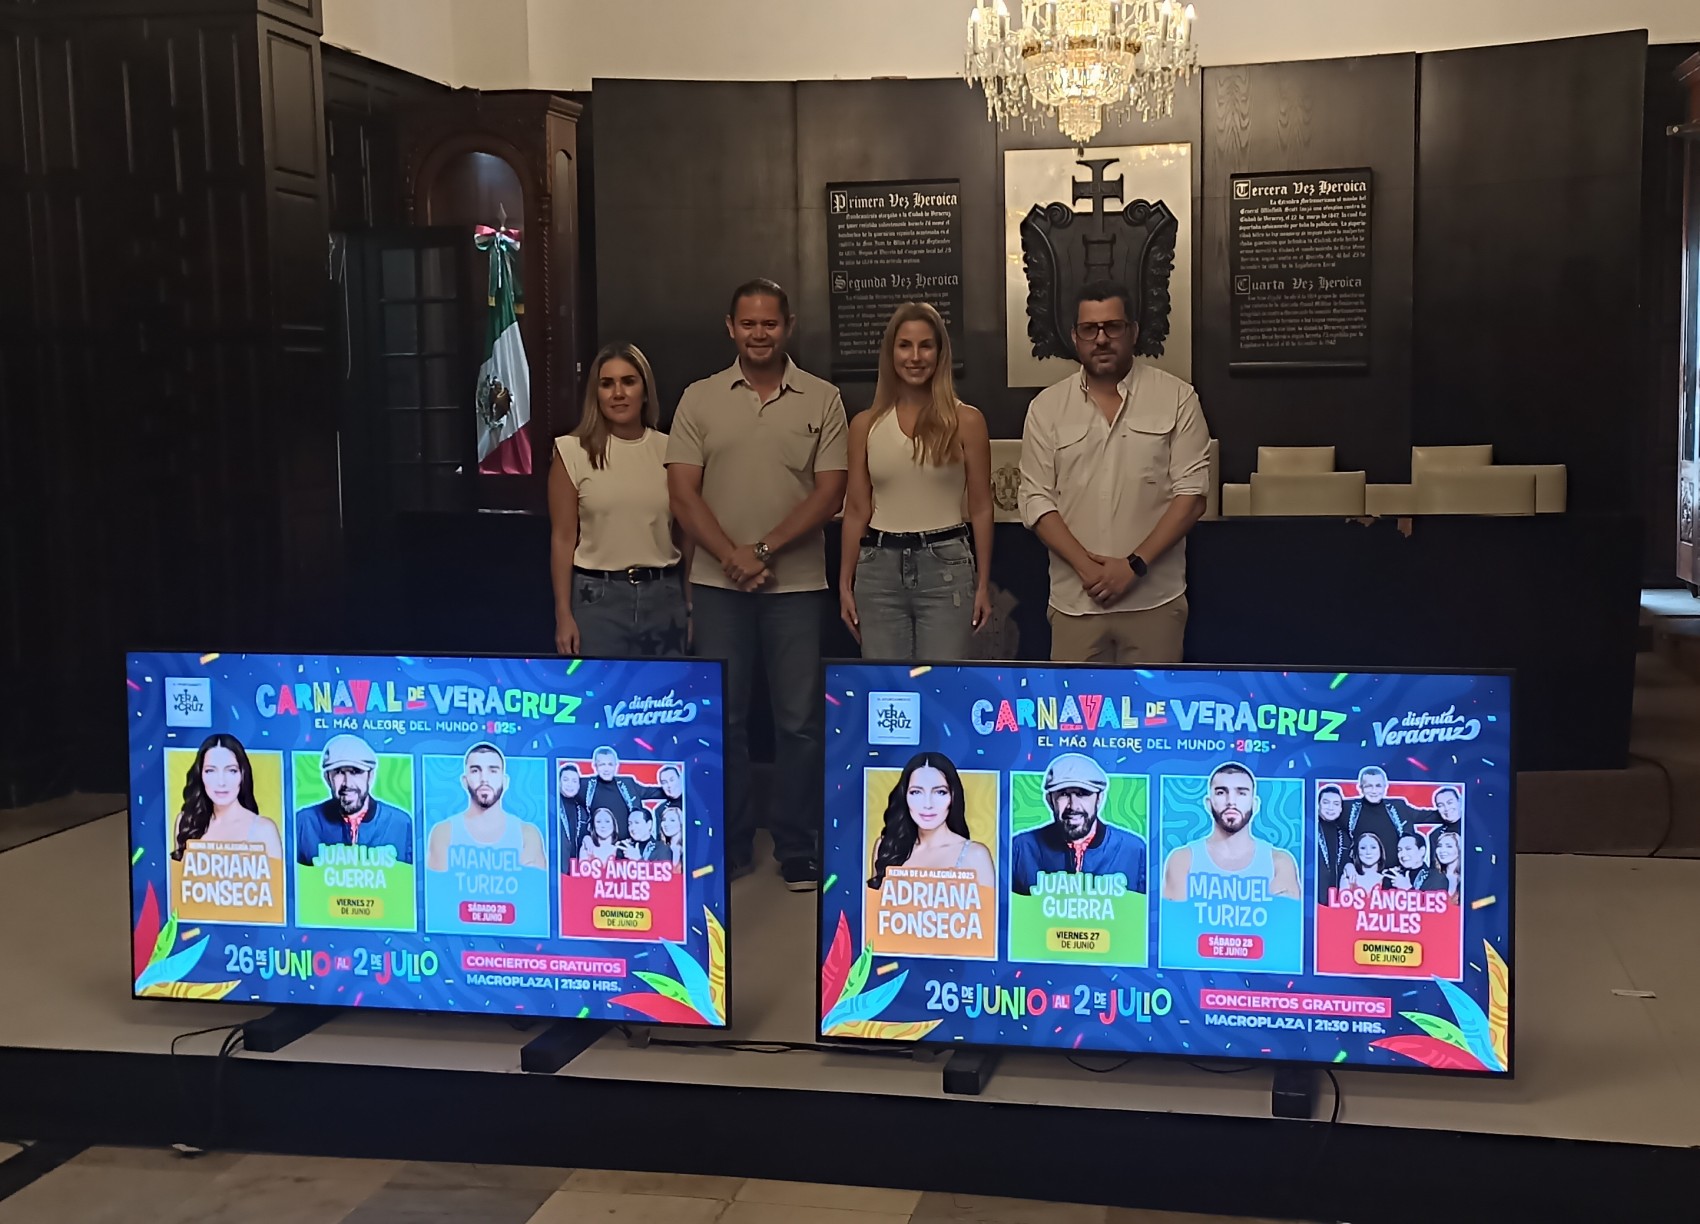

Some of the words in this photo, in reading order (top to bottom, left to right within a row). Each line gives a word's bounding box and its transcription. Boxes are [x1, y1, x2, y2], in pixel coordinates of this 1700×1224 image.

[1235, 181, 1288, 198] Tercera
[1293, 182, 1315, 196] Vez
[1319, 180, 1366, 195] Heroica
[832, 193, 885, 212] Primera
[889, 193, 909, 209] Vez
[913, 192, 957, 208] Heroica
[834, 274, 887, 291] Segunda
[891, 273, 911, 289] Vez
[915, 273, 959, 288] Heroica
[1236, 278, 1285, 292] Cuarta
[1293, 277, 1314, 290] Vez
[1318, 276, 1362, 291] Heroica
[173, 693, 199, 702] VERA
[178, 702, 204, 712] CRUZ
[256, 679, 402, 718] CARNAVAL
[407, 686, 426, 701] DE
[428, 684, 582, 723] VERACRUZ
[604, 701, 697, 728] Veracruz
[877, 709, 907, 719] VERA
[882, 718, 912, 729] CRUZ
[971, 694, 1139, 735] CARNAVAL
[1146, 700, 1167, 716] DE
[1170, 699, 1347, 742] VERACRUZ
[315, 718, 329, 729] EL
[362, 719, 407, 735] ALEGRE
[410, 720, 431, 732] DEL
[435, 721, 478, 733] MUNDO
[1372, 717, 1481, 747] Veracruz
[1038, 736, 1054, 748] EL
[1059, 734, 1087, 749] MÁS
[1093, 737, 1143, 752] ALEGRE
[1147, 738, 1171, 750] DEL
[1177, 739, 1226, 751] MUNDO
[183, 852, 271, 880] ADRIANA
[314, 844, 358, 867] JUAN
[360, 845, 397, 868] LUIS
[450, 847, 522, 872] MANUEL
[324, 866, 387, 889] GUERRA
[570, 859, 602, 878] LOS
[606, 856, 673, 881] ÁNGELES
[909, 870, 918, 878] DE
[919, 870, 928, 878] LA
[181, 880, 273, 907] FONSECA
[455, 873, 518, 895] TURIZO
[594, 880, 650, 900] AZULES
[1032, 872, 1082, 896] JUAN
[1086, 873, 1127, 897] LUIS
[1190, 875, 1273, 902] MANUEL
[336, 898, 365, 907] VIERNES
[366, 899, 375, 907] 27
[881, 879, 982, 910] ADRIANA
[1328, 888, 1364, 909] LOS
[1369, 886, 1448, 914] ÁNGELES
[341, 907, 349, 915] DE
[351, 907, 371, 915] JUNIO
[472, 912, 482, 921] DE
[482, 912, 503, 922] JUNIO
[600, 909, 634, 919] DOMINGO
[635, 910, 645, 919] 29
[1042, 896, 1115, 921] GUERRA
[1194, 902, 1268, 928] TURIZO
[607, 918, 615, 927] DE
[617, 919, 638, 928] JUNIO
[878, 910, 983, 940] FONSECA
[1355, 911, 1421, 934] AZULES
[1056, 931, 1089, 940] VIERNES
[1090, 932, 1100, 941] 27
[1061, 940, 1071, 949] DE
[1072, 941, 1095, 950] JUNIO
[1208, 936, 1241, 947] SÁBADO
[1242, 938, 1254, 947] 28
[224, 944, 254, 974] 26
[256, 949, 267, 961] DE
[1213, 947, 1223, 956] DE
[1224, 947, 1248, 957] JUNIO
[1362, 944, 1401, 954] DOMINGO
[1403, 945, 1414, 954] 29
[1370, 953, 1380, 962] DE
[1382, 954, 1406, 963] JUNIO
[259, 947, 331, 981] JUNIO
[335, 957, 349, 970] AL
[353, 948, 369, 976] 2
[371, 954, 382, 966] DE
[376, 949, 439, 985] JULIO
[466, 955, 547, 970] CONCIERTOS
[550, 959, 622, 974] GRATUITOS
[466, 973, 552, 989] MACROPLAZA
[561, 977, 589, 991] 21:30
[592, 979, 622, 993] HRS.
[961, 986, 974, 999] DE
[924, 980, 958, 1012] 26
[965, 983, 1047, 1020] JUNIO
[1053, 995, 1069, 1009] AL
[1074, 984, 1091, 1016] 2
[1094, 992, 1107, 1005] DE
[1205, 993, 1299, 1010] CONCIERTOS
[1302, 998, 1386, 1014] GRATUITOS
[1099, 988, 1172, 1025] JULIO
[1205, 1014, 1305, 1030] MACROPLAZA
[1314, 1019, 1349, 1033] 21:30
[1352, 1021, 1386, 1034] HRS.
